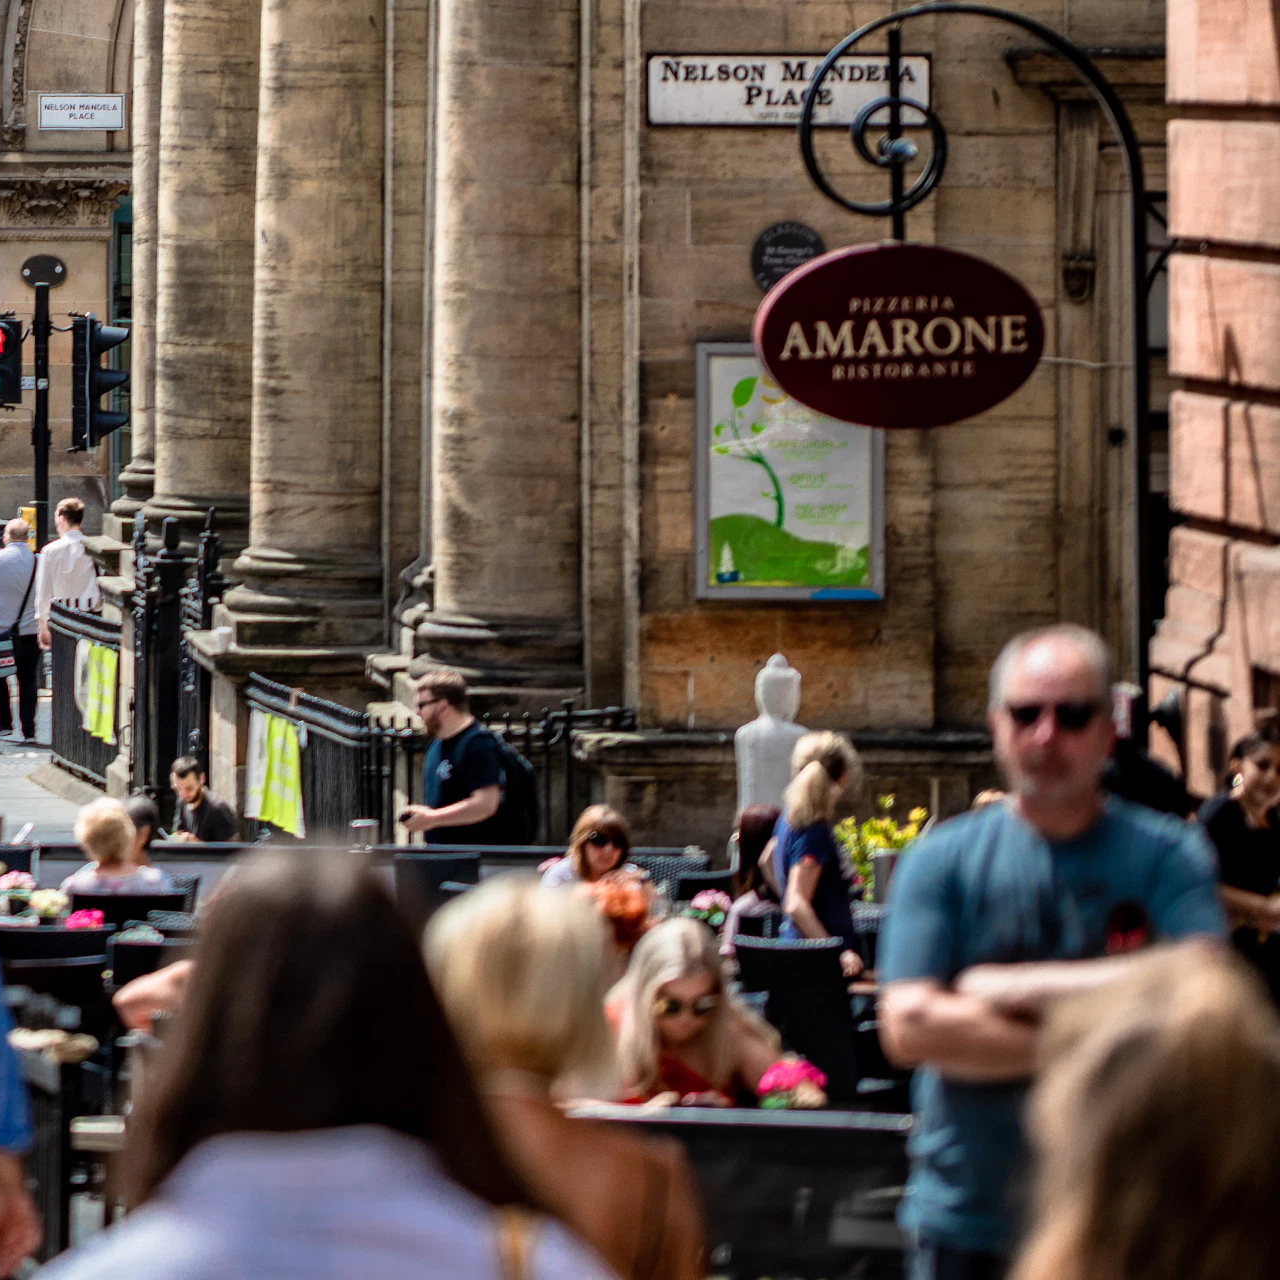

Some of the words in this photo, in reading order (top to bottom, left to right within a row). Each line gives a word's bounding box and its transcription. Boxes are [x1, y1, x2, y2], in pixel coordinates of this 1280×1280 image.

[661, 60, 767, 83] NELSON
[849, 295, 956, 315] PIZZERIA
[779, 315, 1030, 361] AMARONE
[831, 359, 978, 382] RISTORANTE
